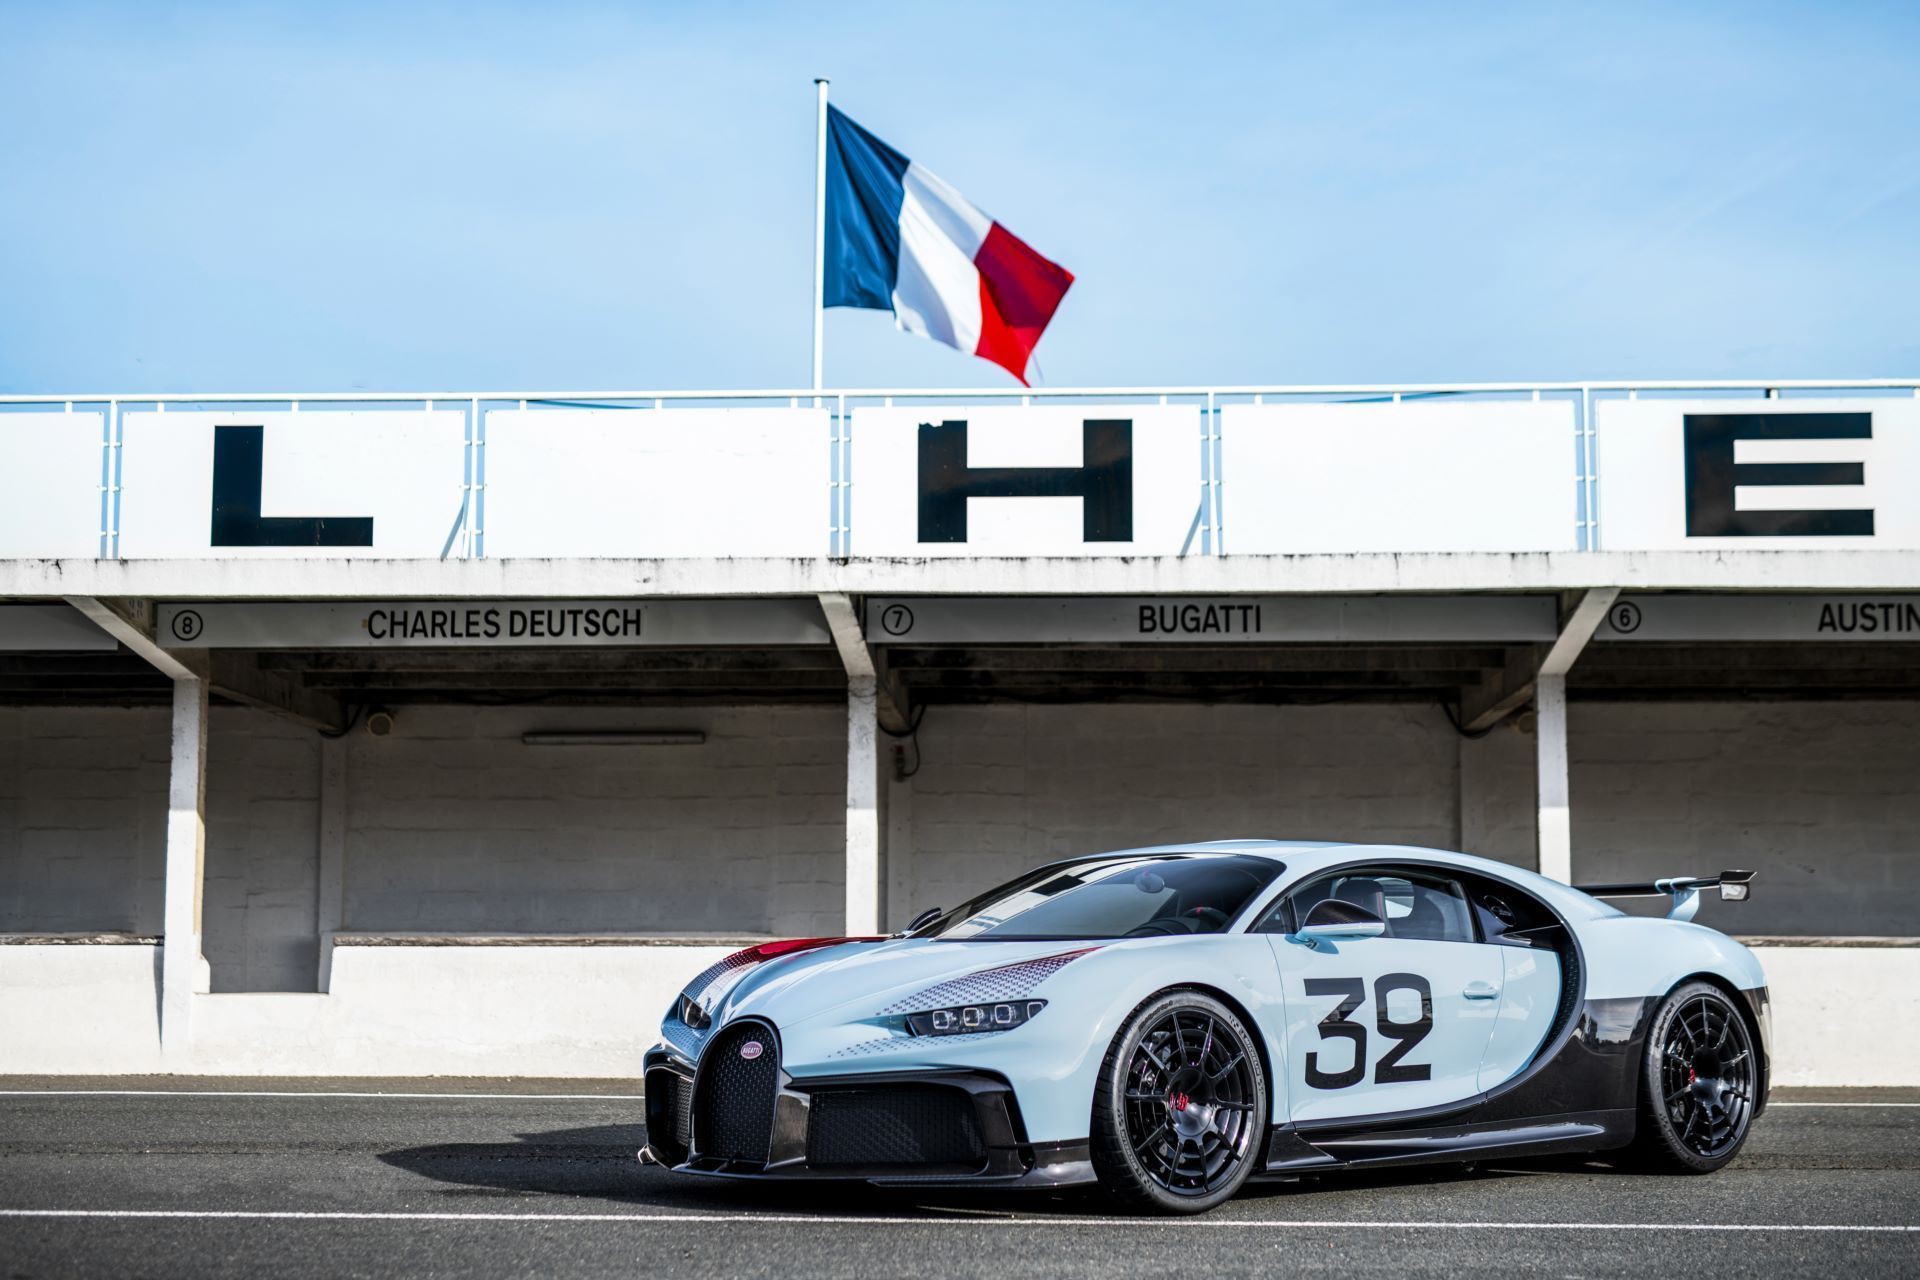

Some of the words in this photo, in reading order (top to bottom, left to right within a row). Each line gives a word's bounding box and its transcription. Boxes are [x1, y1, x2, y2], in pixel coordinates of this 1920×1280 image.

[211, 426, 373, 546] L
[918, 419, 1133, 543] H
[1683, 412, 1875, 537] E
[182, 616, 193, 635] 8
[368, 609, 500, 639] CHARLES
[509, 608, 641, 638] DEUTSCH
[891, 610, 904, 629] 7
[1138, 604, 1261, 634] BUGATTI
[1620, 607, 1631, 628] 6
[1303, 972, 1433, 1090] 32
